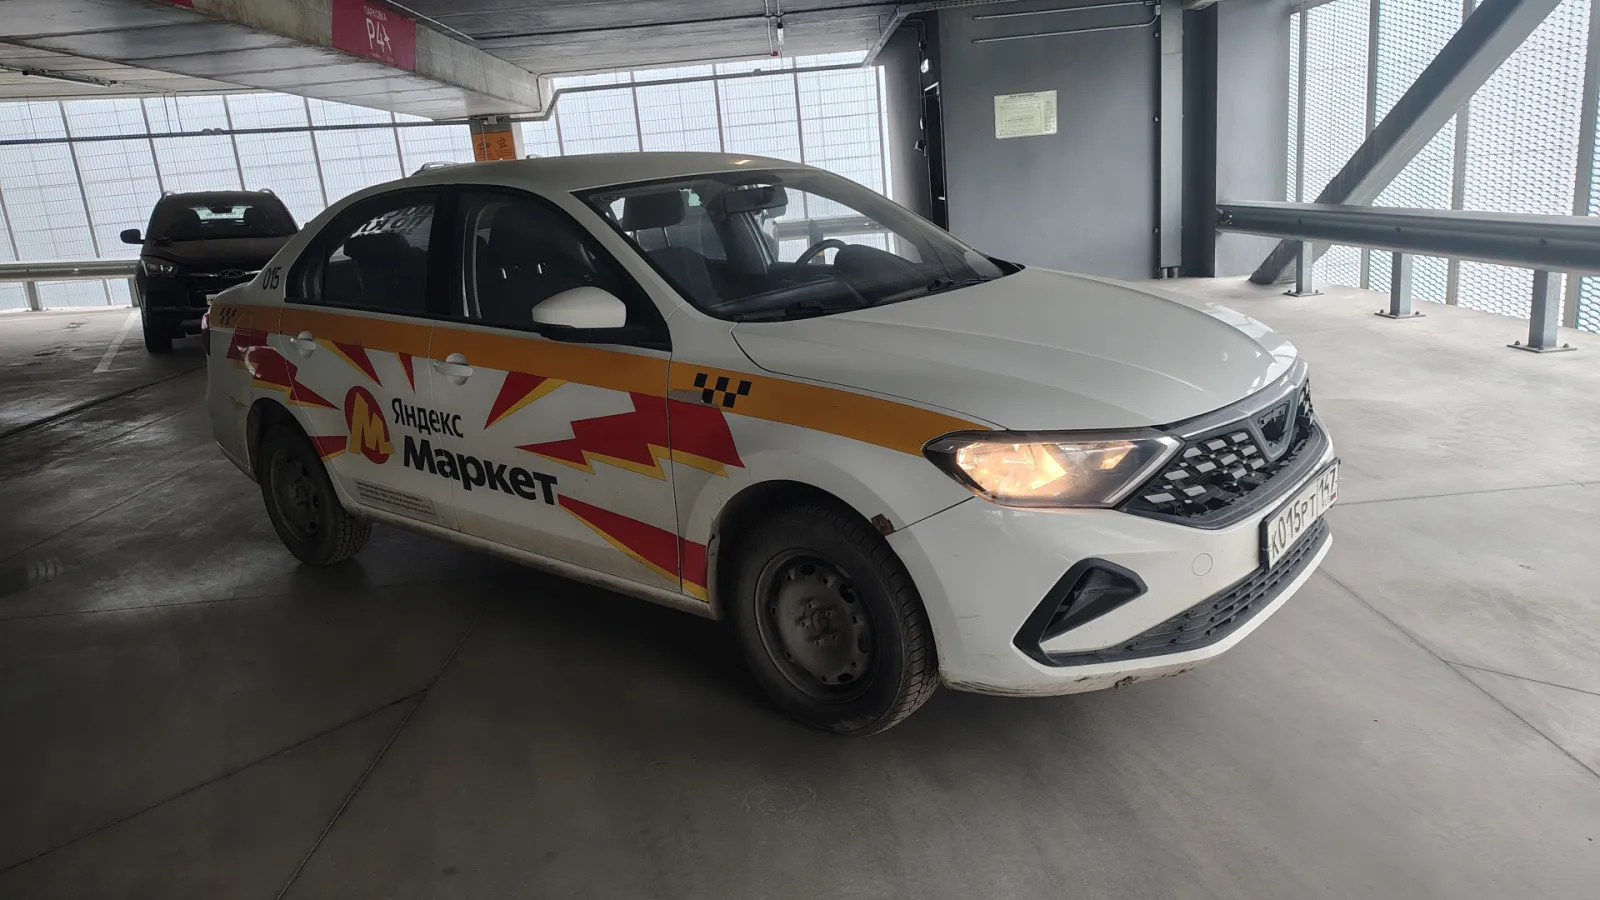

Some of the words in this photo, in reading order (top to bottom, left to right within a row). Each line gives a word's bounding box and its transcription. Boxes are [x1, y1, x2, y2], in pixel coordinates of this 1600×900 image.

[363, 5, 388, 22] ПАРКОВКА
[262, 266, 282, 290] 015
[391, 397, 464, 438] Яндекс
[403, 435, 558, 506] Маркет
